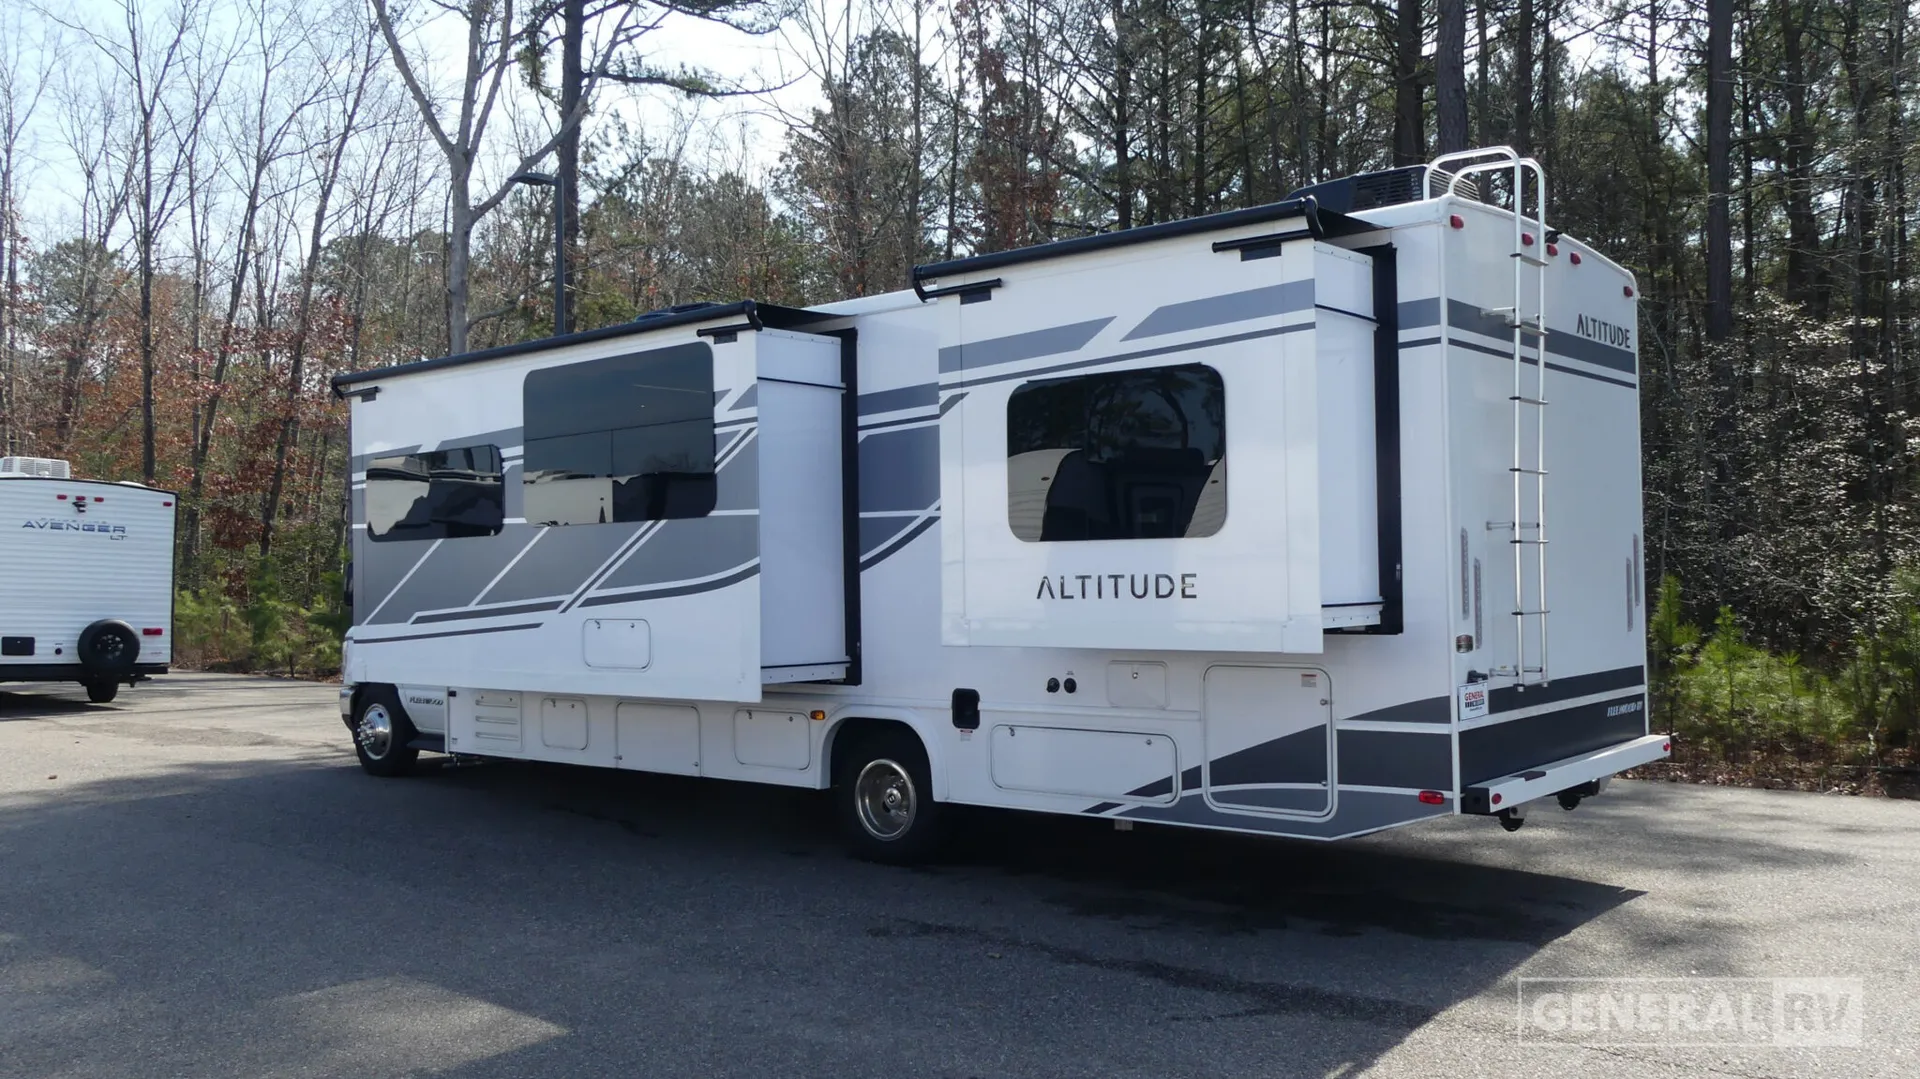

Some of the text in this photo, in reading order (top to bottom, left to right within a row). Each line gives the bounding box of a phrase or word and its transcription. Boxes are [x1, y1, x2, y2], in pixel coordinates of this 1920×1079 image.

[1576, 313, 1631, 349] ALTITUDE
[22, 520, 126, 534] AVENGER
[1036, 573, 1198, 600] ALTITUDE
